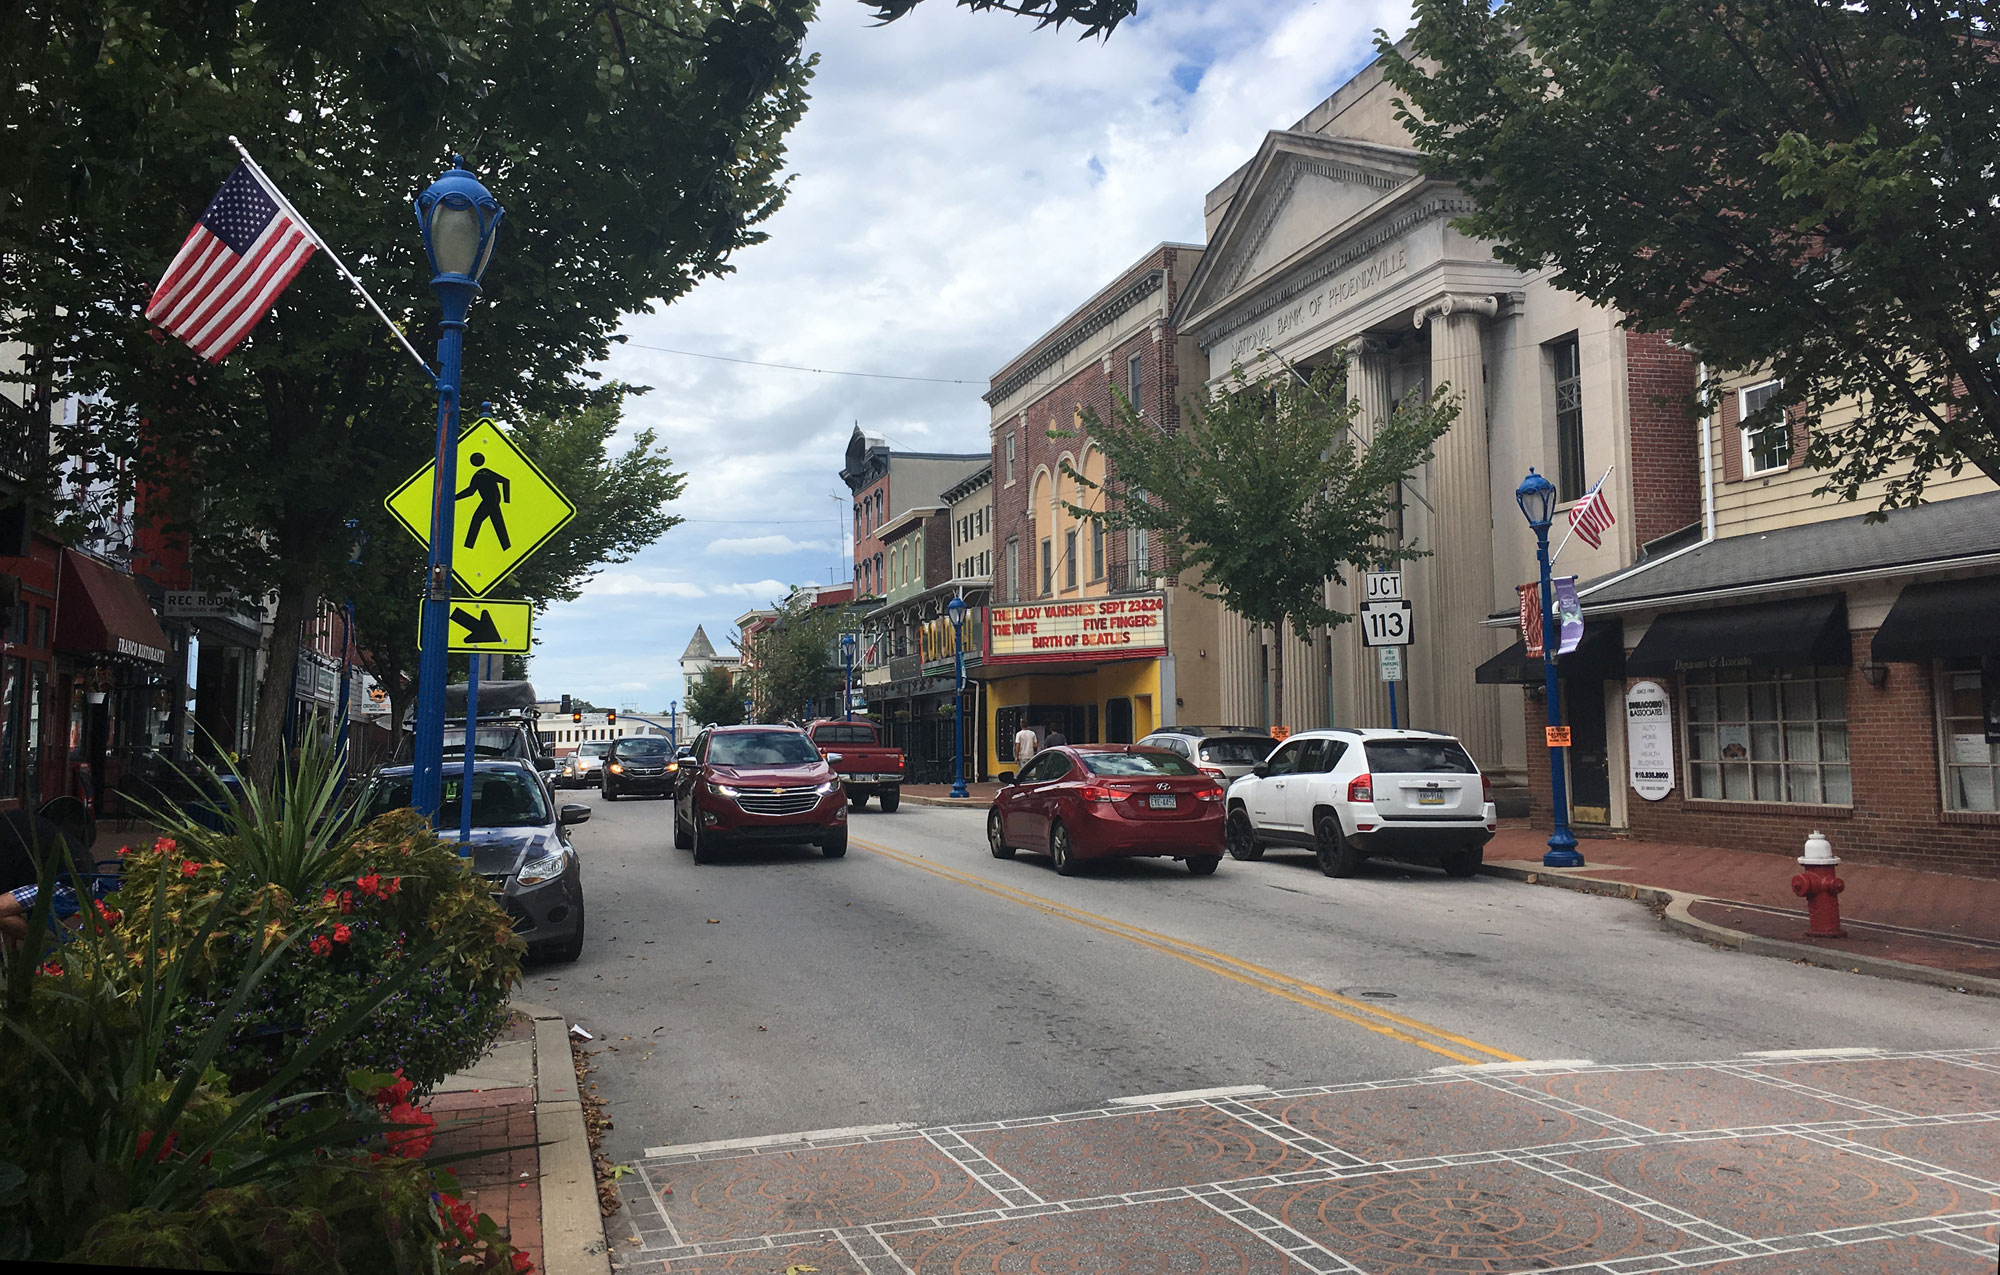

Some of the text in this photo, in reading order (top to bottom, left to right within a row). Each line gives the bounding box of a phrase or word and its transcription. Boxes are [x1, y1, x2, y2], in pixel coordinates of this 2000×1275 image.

[1231, 249, 1407, 358] NATIONAL BANK OF PHOENIXVILLE
[1369, 576, 1399, 596] JCT
[168, 595, 192, 605] REC
[992, 598, 1164, 622] THE LADY VANISHES SEPT 23&24
[992, 614, 1157, 637] THE WIFE FIVE FINGERS
[1370, 612, 1404, 637] 113
[117, 637, 138, 656] FRANCO
[1032, 632, 1130, 649] BIRTH OF BEATLES
